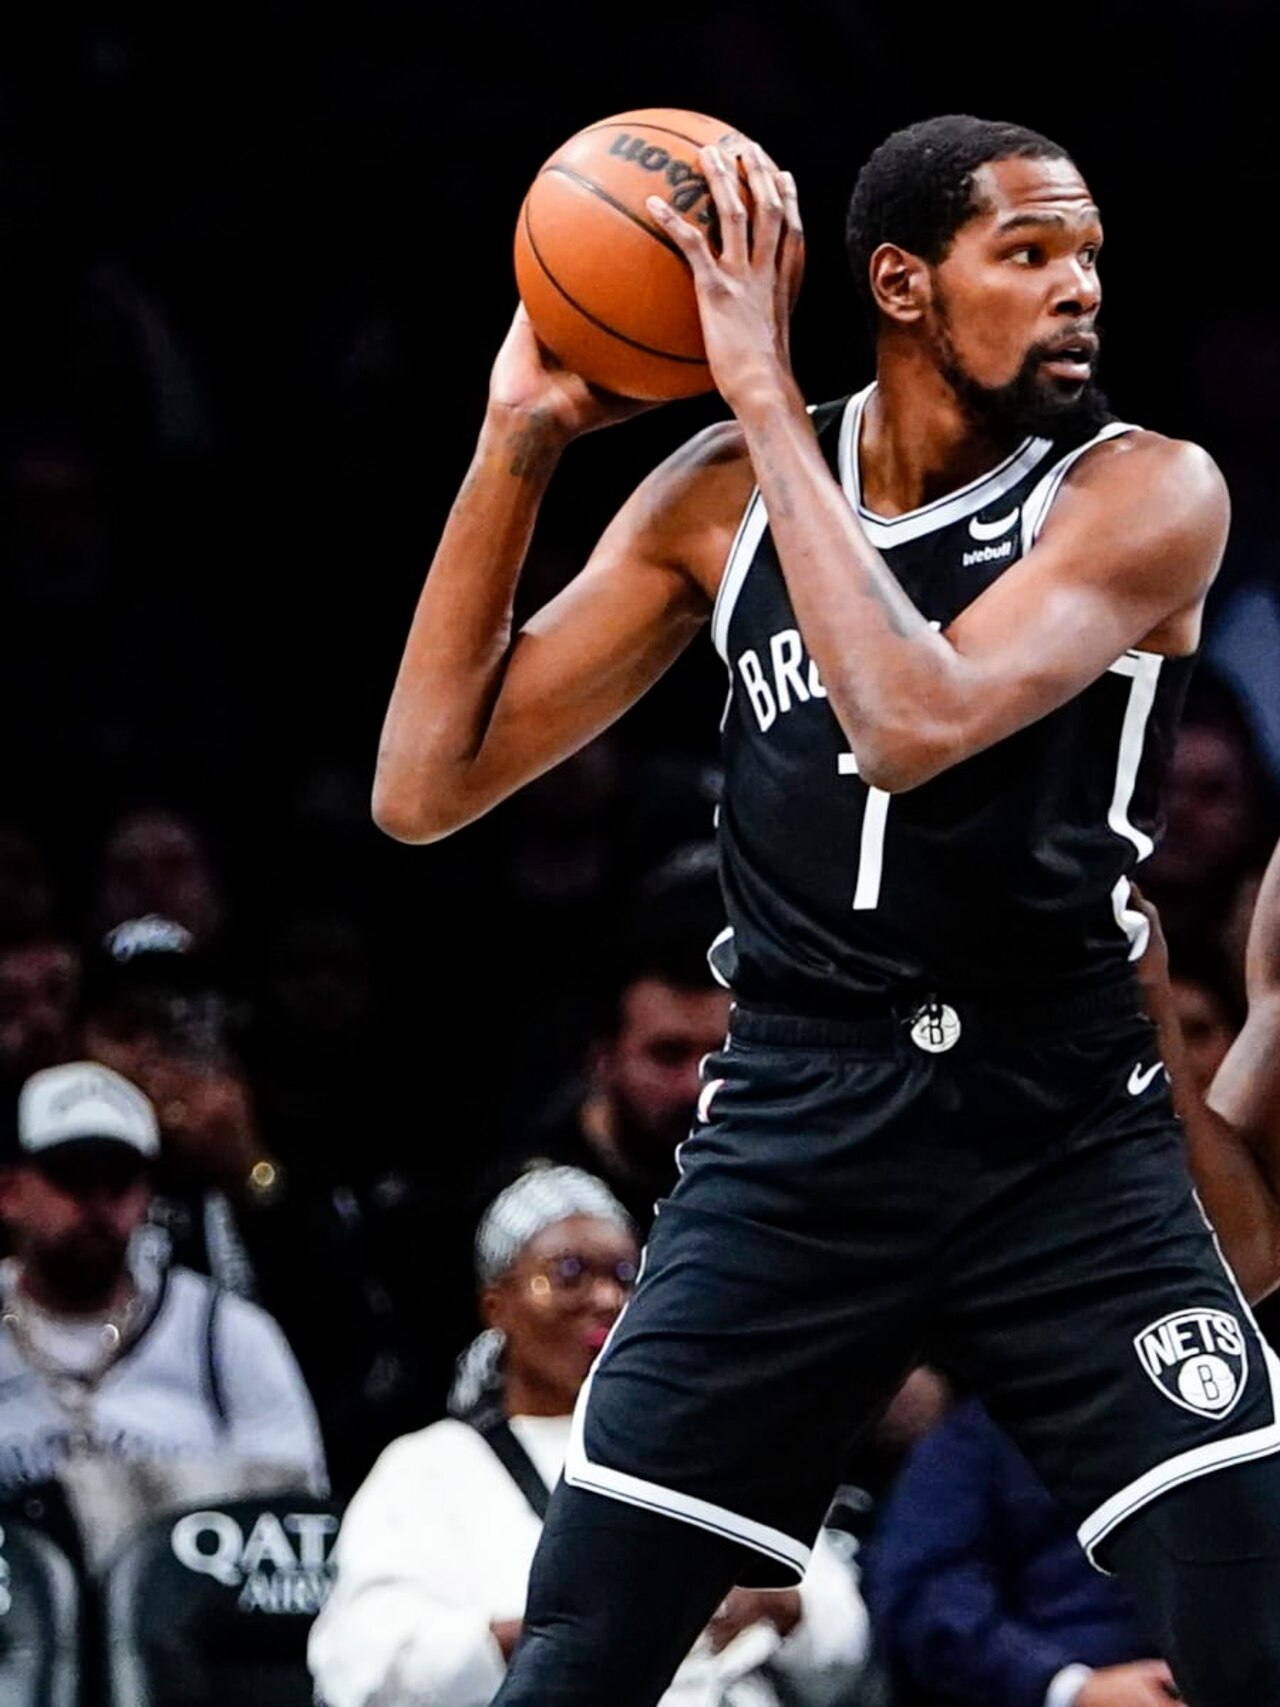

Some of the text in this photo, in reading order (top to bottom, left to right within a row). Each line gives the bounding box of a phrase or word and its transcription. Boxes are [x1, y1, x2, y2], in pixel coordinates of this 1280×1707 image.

[837, 752, 891, 911] 7
[1142, 1313, 1242, 1376] NETS
[1197, 1364, 1220, 1401] B
[171, 1511, 340, 1586] QAT
